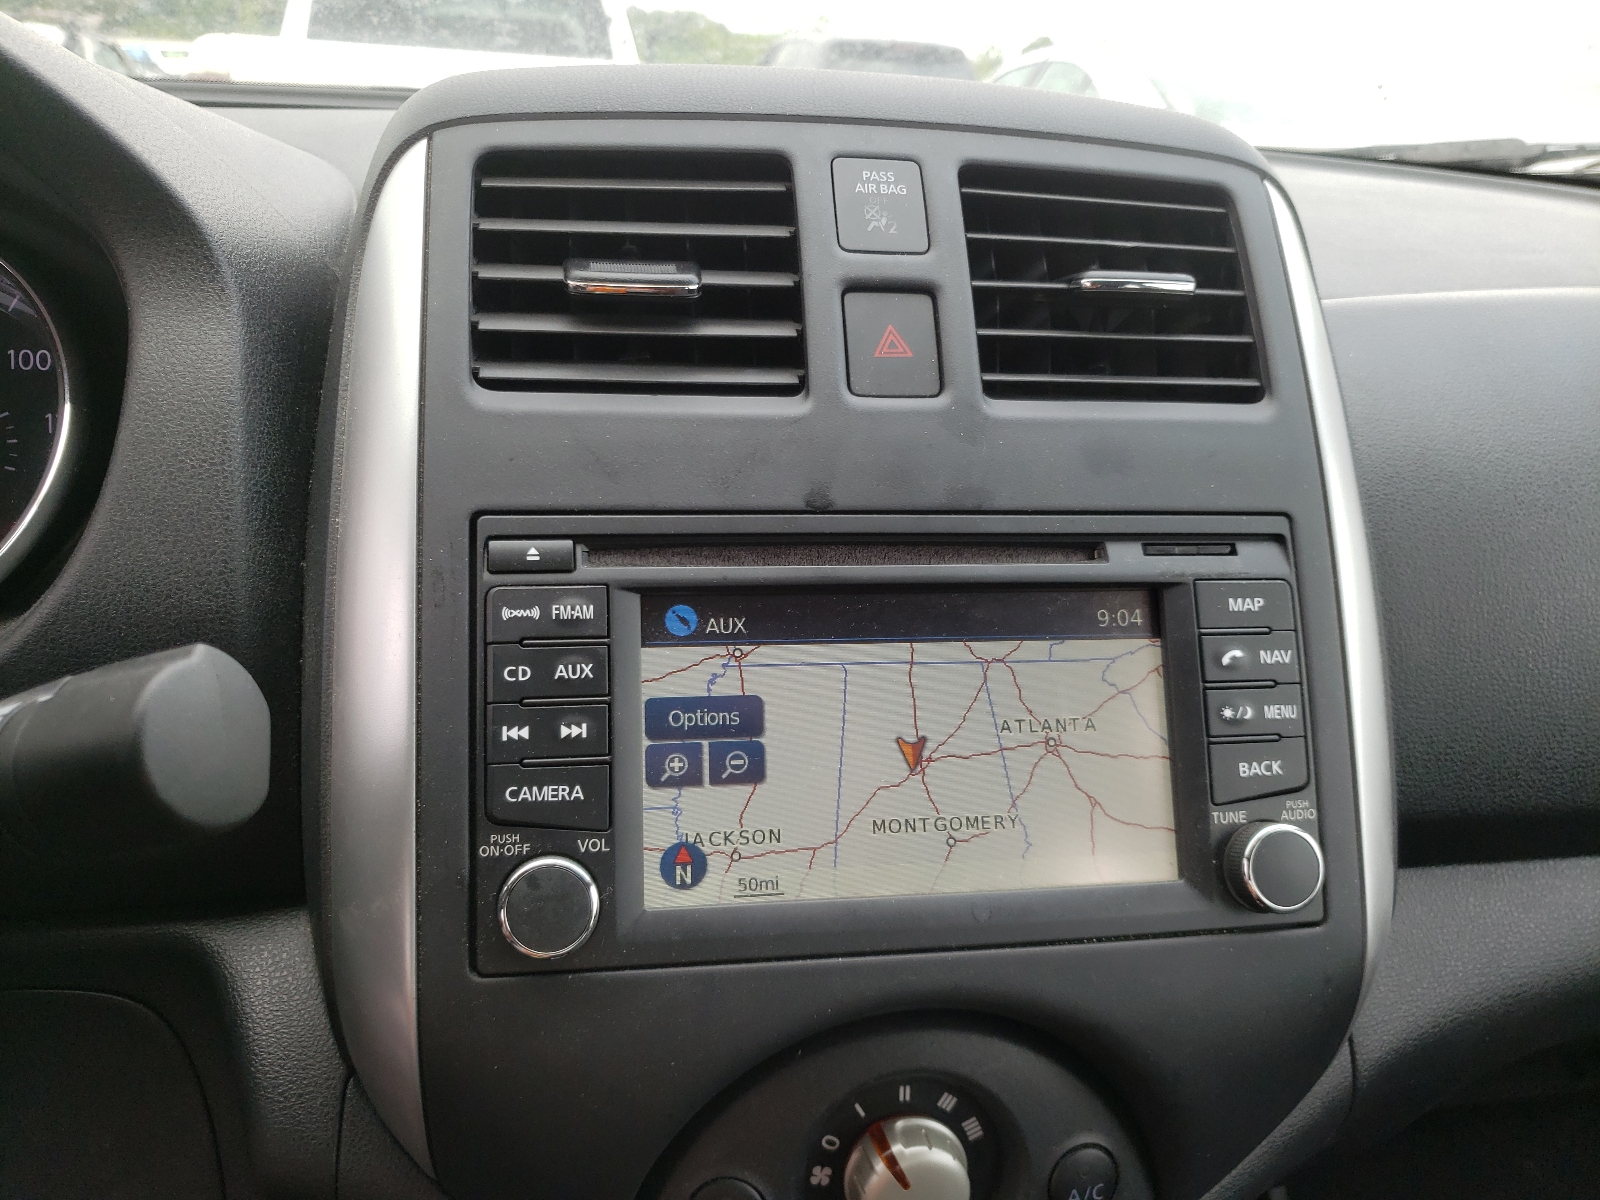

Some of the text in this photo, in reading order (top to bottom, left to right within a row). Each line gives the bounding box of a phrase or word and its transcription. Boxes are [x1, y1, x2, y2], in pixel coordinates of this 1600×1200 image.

[862, 170, 895, 182] PASS
[855, 182, 907, 195] AIR BAG
[869, 197, 889, 205] OFF
[7, 348, 52, 372] 100
[1227, 596, 1264, 613] MAP
[705, 616, 748, 635] AUX
[1096, 608, 1144, 628] 9:04
[1259, 648, 1292, 665] NAV
[503, 663, 595, 682] CD AUX
[668, 709, 741, 730] Options
[1263, 704, 1297, 720] MENU
[1000, 716, 1097, 734] ATLANTA
[1238, 759, 1283, 778] BACK
[504, 784, 585, 803] CAMERA
[1285, 799, 1309, 809] PUSH
[1211, 810, 1248, 825] TUNE
[1280, 808, 1316, 822] AUDIO
[871, 813, 1020, 836] MONTGOMERY
[490, 833, 520, 845] PUSH
[577, 838, 611, 854] VOL
[675, 865, 693, 885] N
[737, 876, 780, 892] 50mi
[1068, 1183, 1105, 1200] A/C
